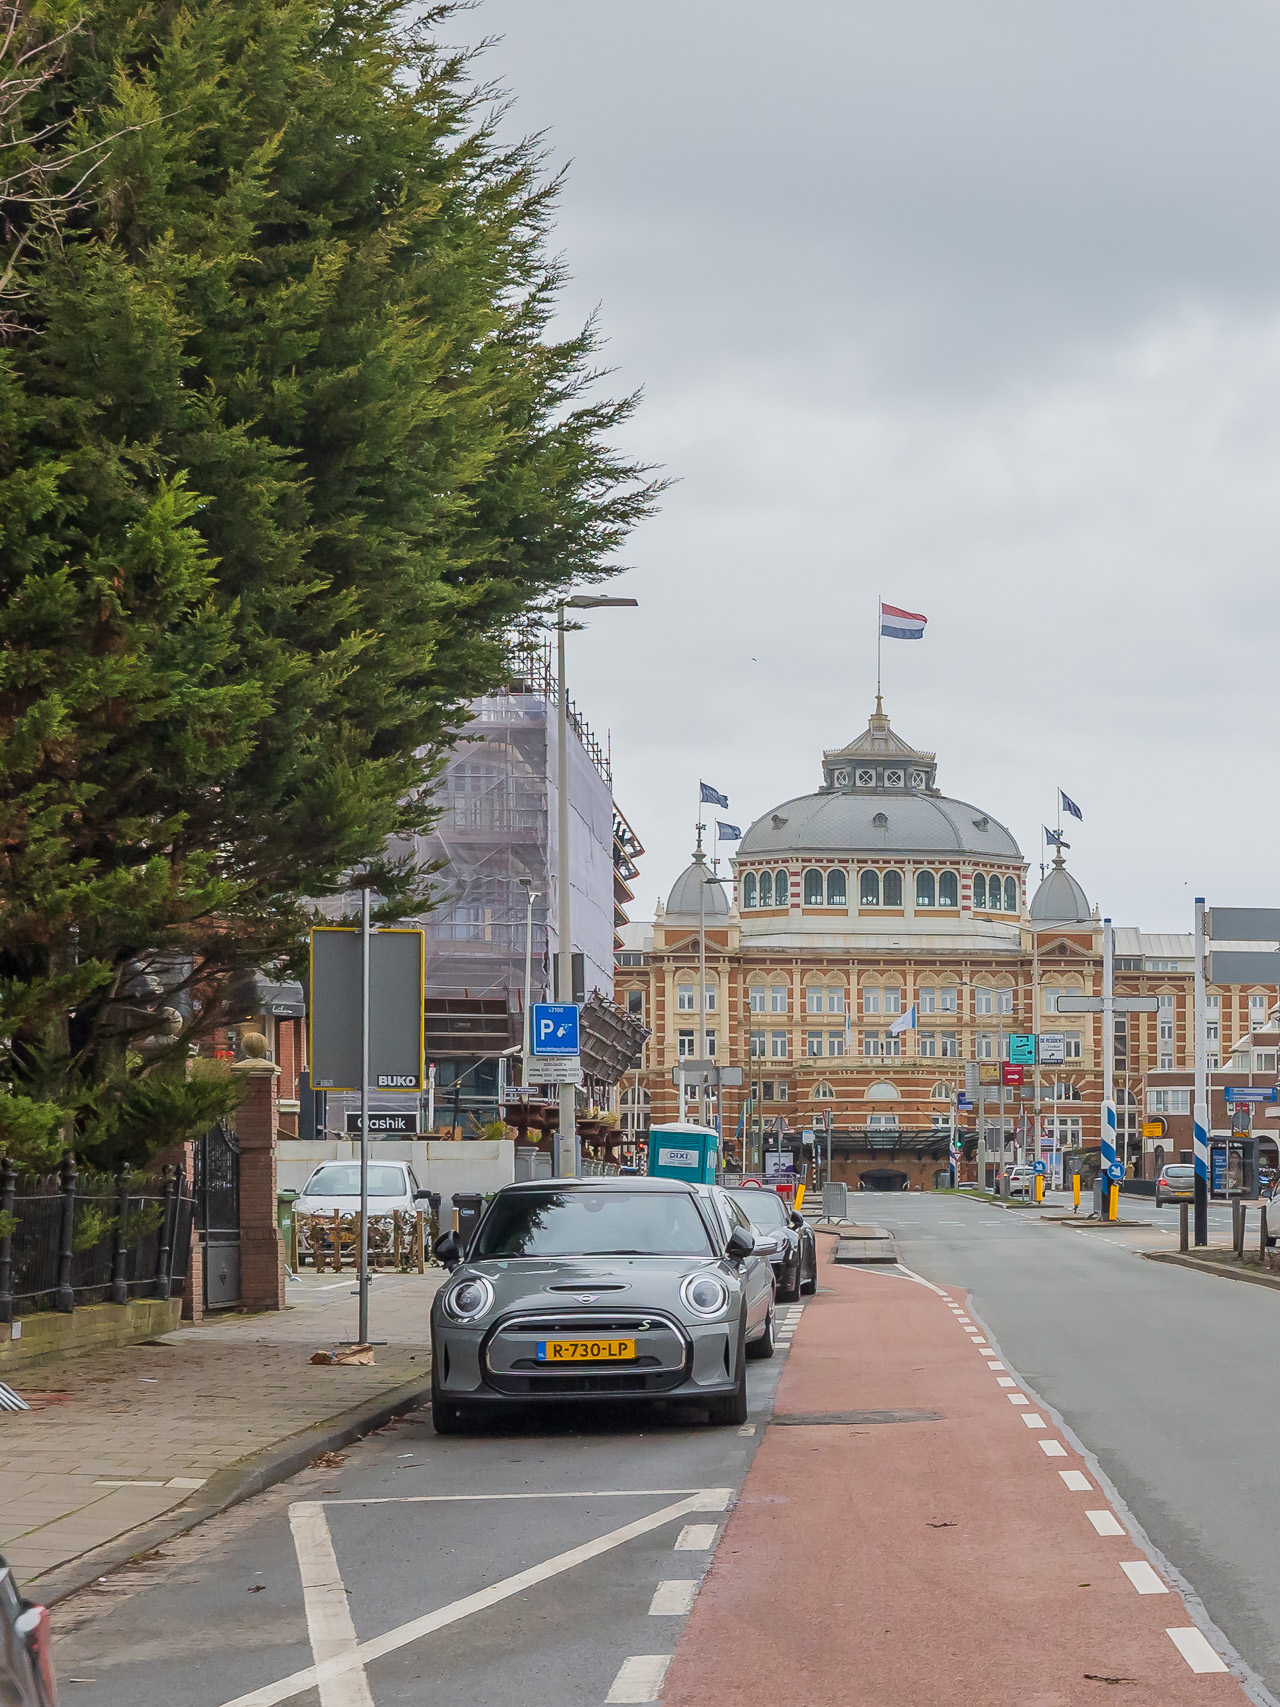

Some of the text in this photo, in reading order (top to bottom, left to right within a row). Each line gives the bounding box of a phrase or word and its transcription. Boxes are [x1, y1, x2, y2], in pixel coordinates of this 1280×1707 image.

[540, 1019, 554, 1040] P
[378, 1076, 416, 1086] BUKO
[669, 1152, 688, 1160] DIXI
[553, 1342, 628, 1358] R-730-LP
